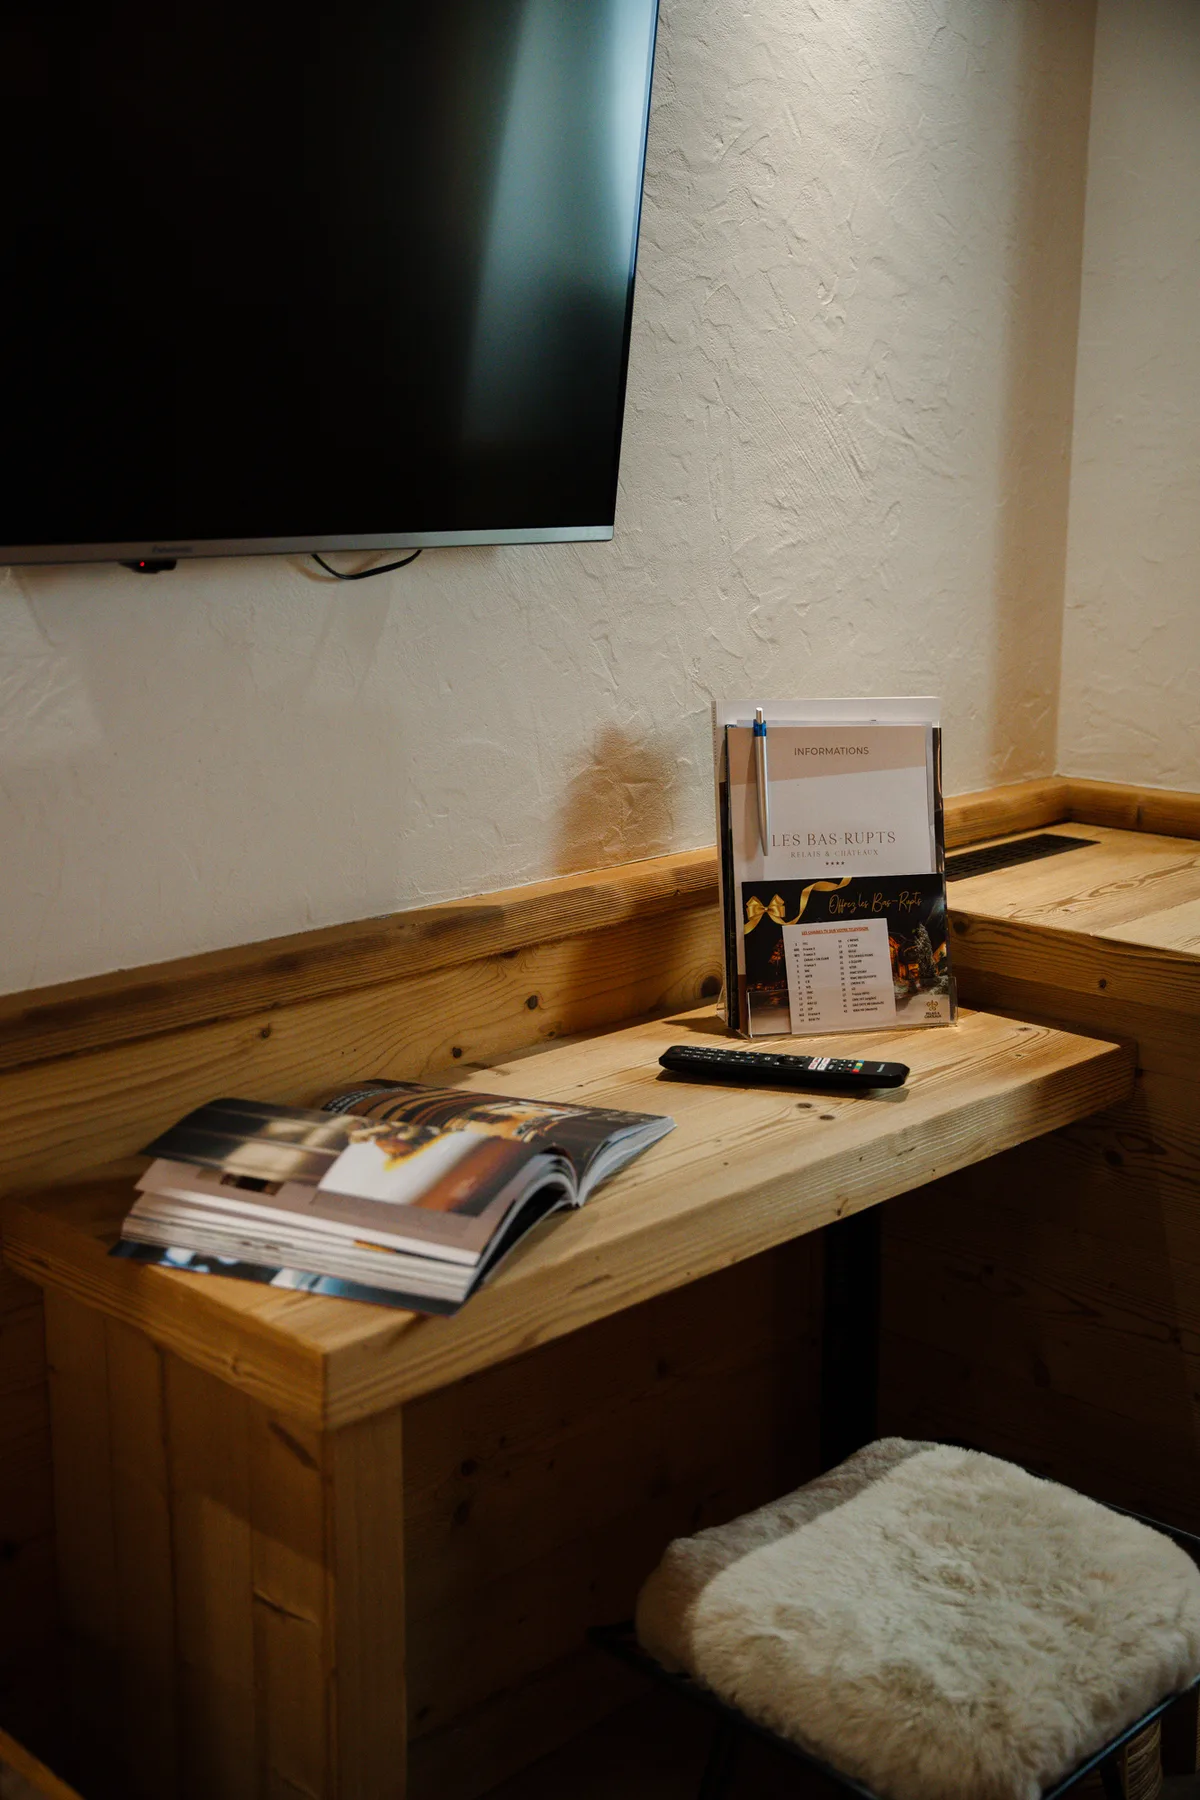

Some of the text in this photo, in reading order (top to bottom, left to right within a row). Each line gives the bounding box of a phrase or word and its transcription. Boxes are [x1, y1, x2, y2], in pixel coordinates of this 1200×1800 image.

[794, 746, 870, 756] INFORMATIONS
[772, 834, 801, 847] LES
[790, 851, 821, 859] RELAIS
[857, 893, 869, 909] les
